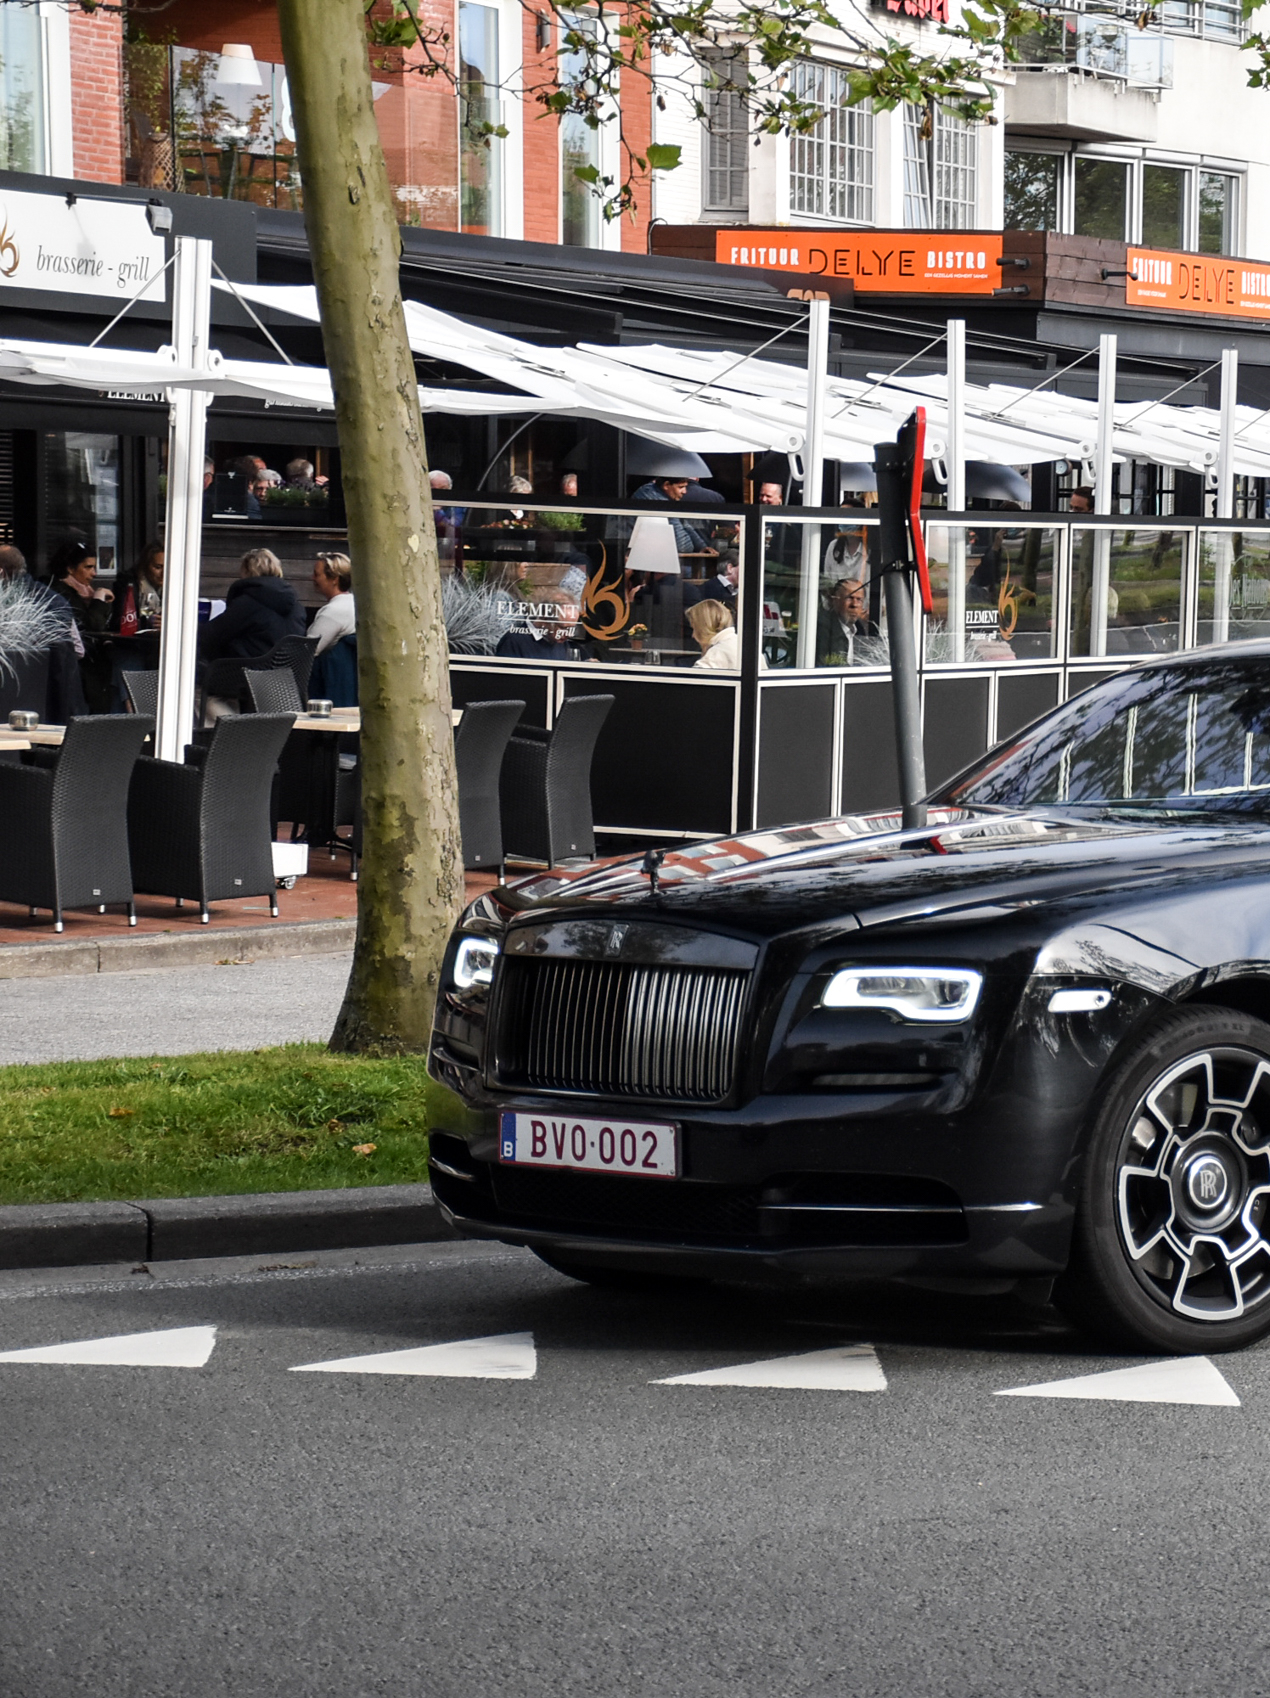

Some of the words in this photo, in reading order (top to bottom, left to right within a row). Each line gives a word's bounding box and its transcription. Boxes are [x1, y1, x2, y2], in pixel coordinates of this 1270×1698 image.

[36, 245, 103, 277] brasserie
[117, 256, 149, 288] grill
[731, 247, 799, 266] FRITUUR
[809, 248, 915, 276] DELYE
[927, 251, 986, 270] BISTRO
[1132, 257, 1172, 286] FRITUUR
[1178, 263, 1235, 304] DELYE
[1241, 271, 1270, 297] BISTRO
[497, 601, 580, 619] ELEMENT
[966, 610, 999, 624] ELEMENT
[555, 626, 576, 639] grill
[504, 1142, 513, 1157] B
